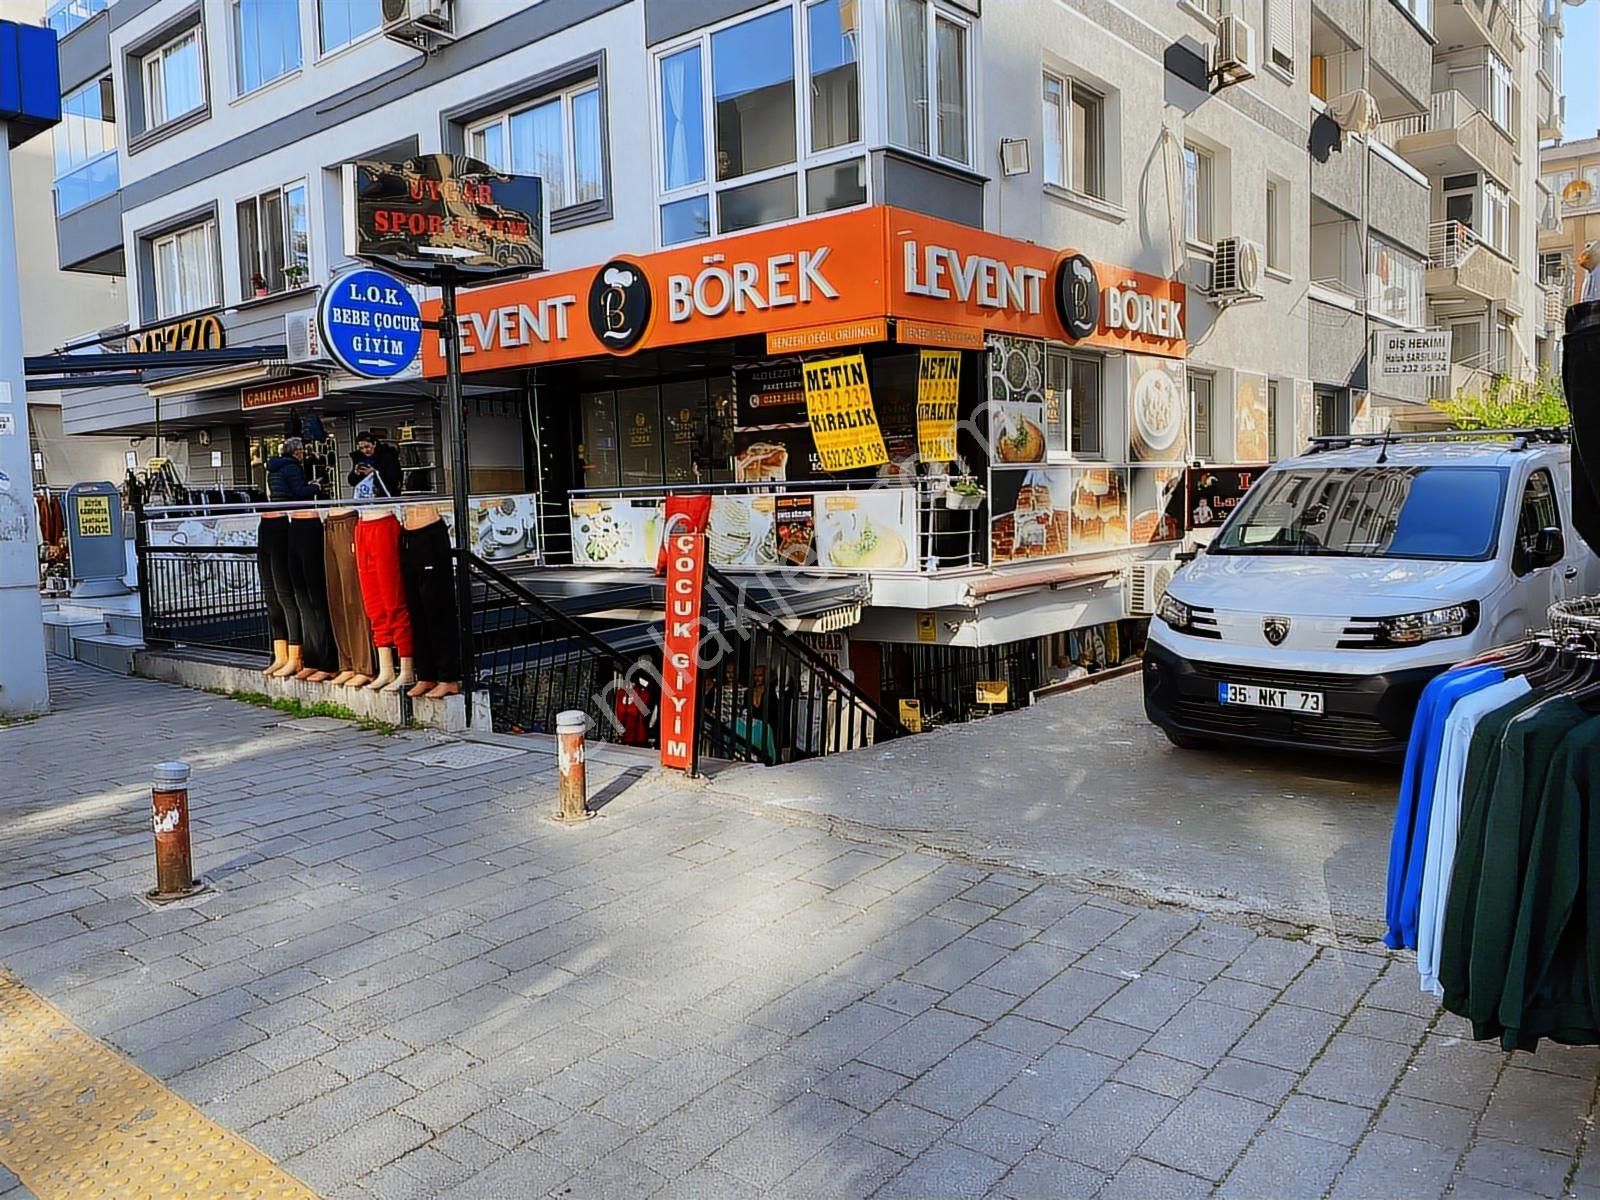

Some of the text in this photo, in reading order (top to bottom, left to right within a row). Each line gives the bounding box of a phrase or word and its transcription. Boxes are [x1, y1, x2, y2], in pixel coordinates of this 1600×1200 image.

[374, 210, 443, 236] SPOR
[349, 283, 403, 306] L.O.K.
[668, 246, 840, 323] BÖREK
[904, 241, 1046, 314] LEVENT
[1105, 279, 1184, 338] BÖREK
[332, 307, 420, 332] BEBE ÇOCUK
[352, 332, 404, 355] GİYİM
[1389, 335, 1446, 351] DİŞ HEKİMİ
[809, 386, 870, 413] 232 2 232
[81, 525, 101, 534] 300
[666, 535, 696, 757] ÇOCUK GİYİM
[1229, 686, 1320, 711] 35 NKT 73
